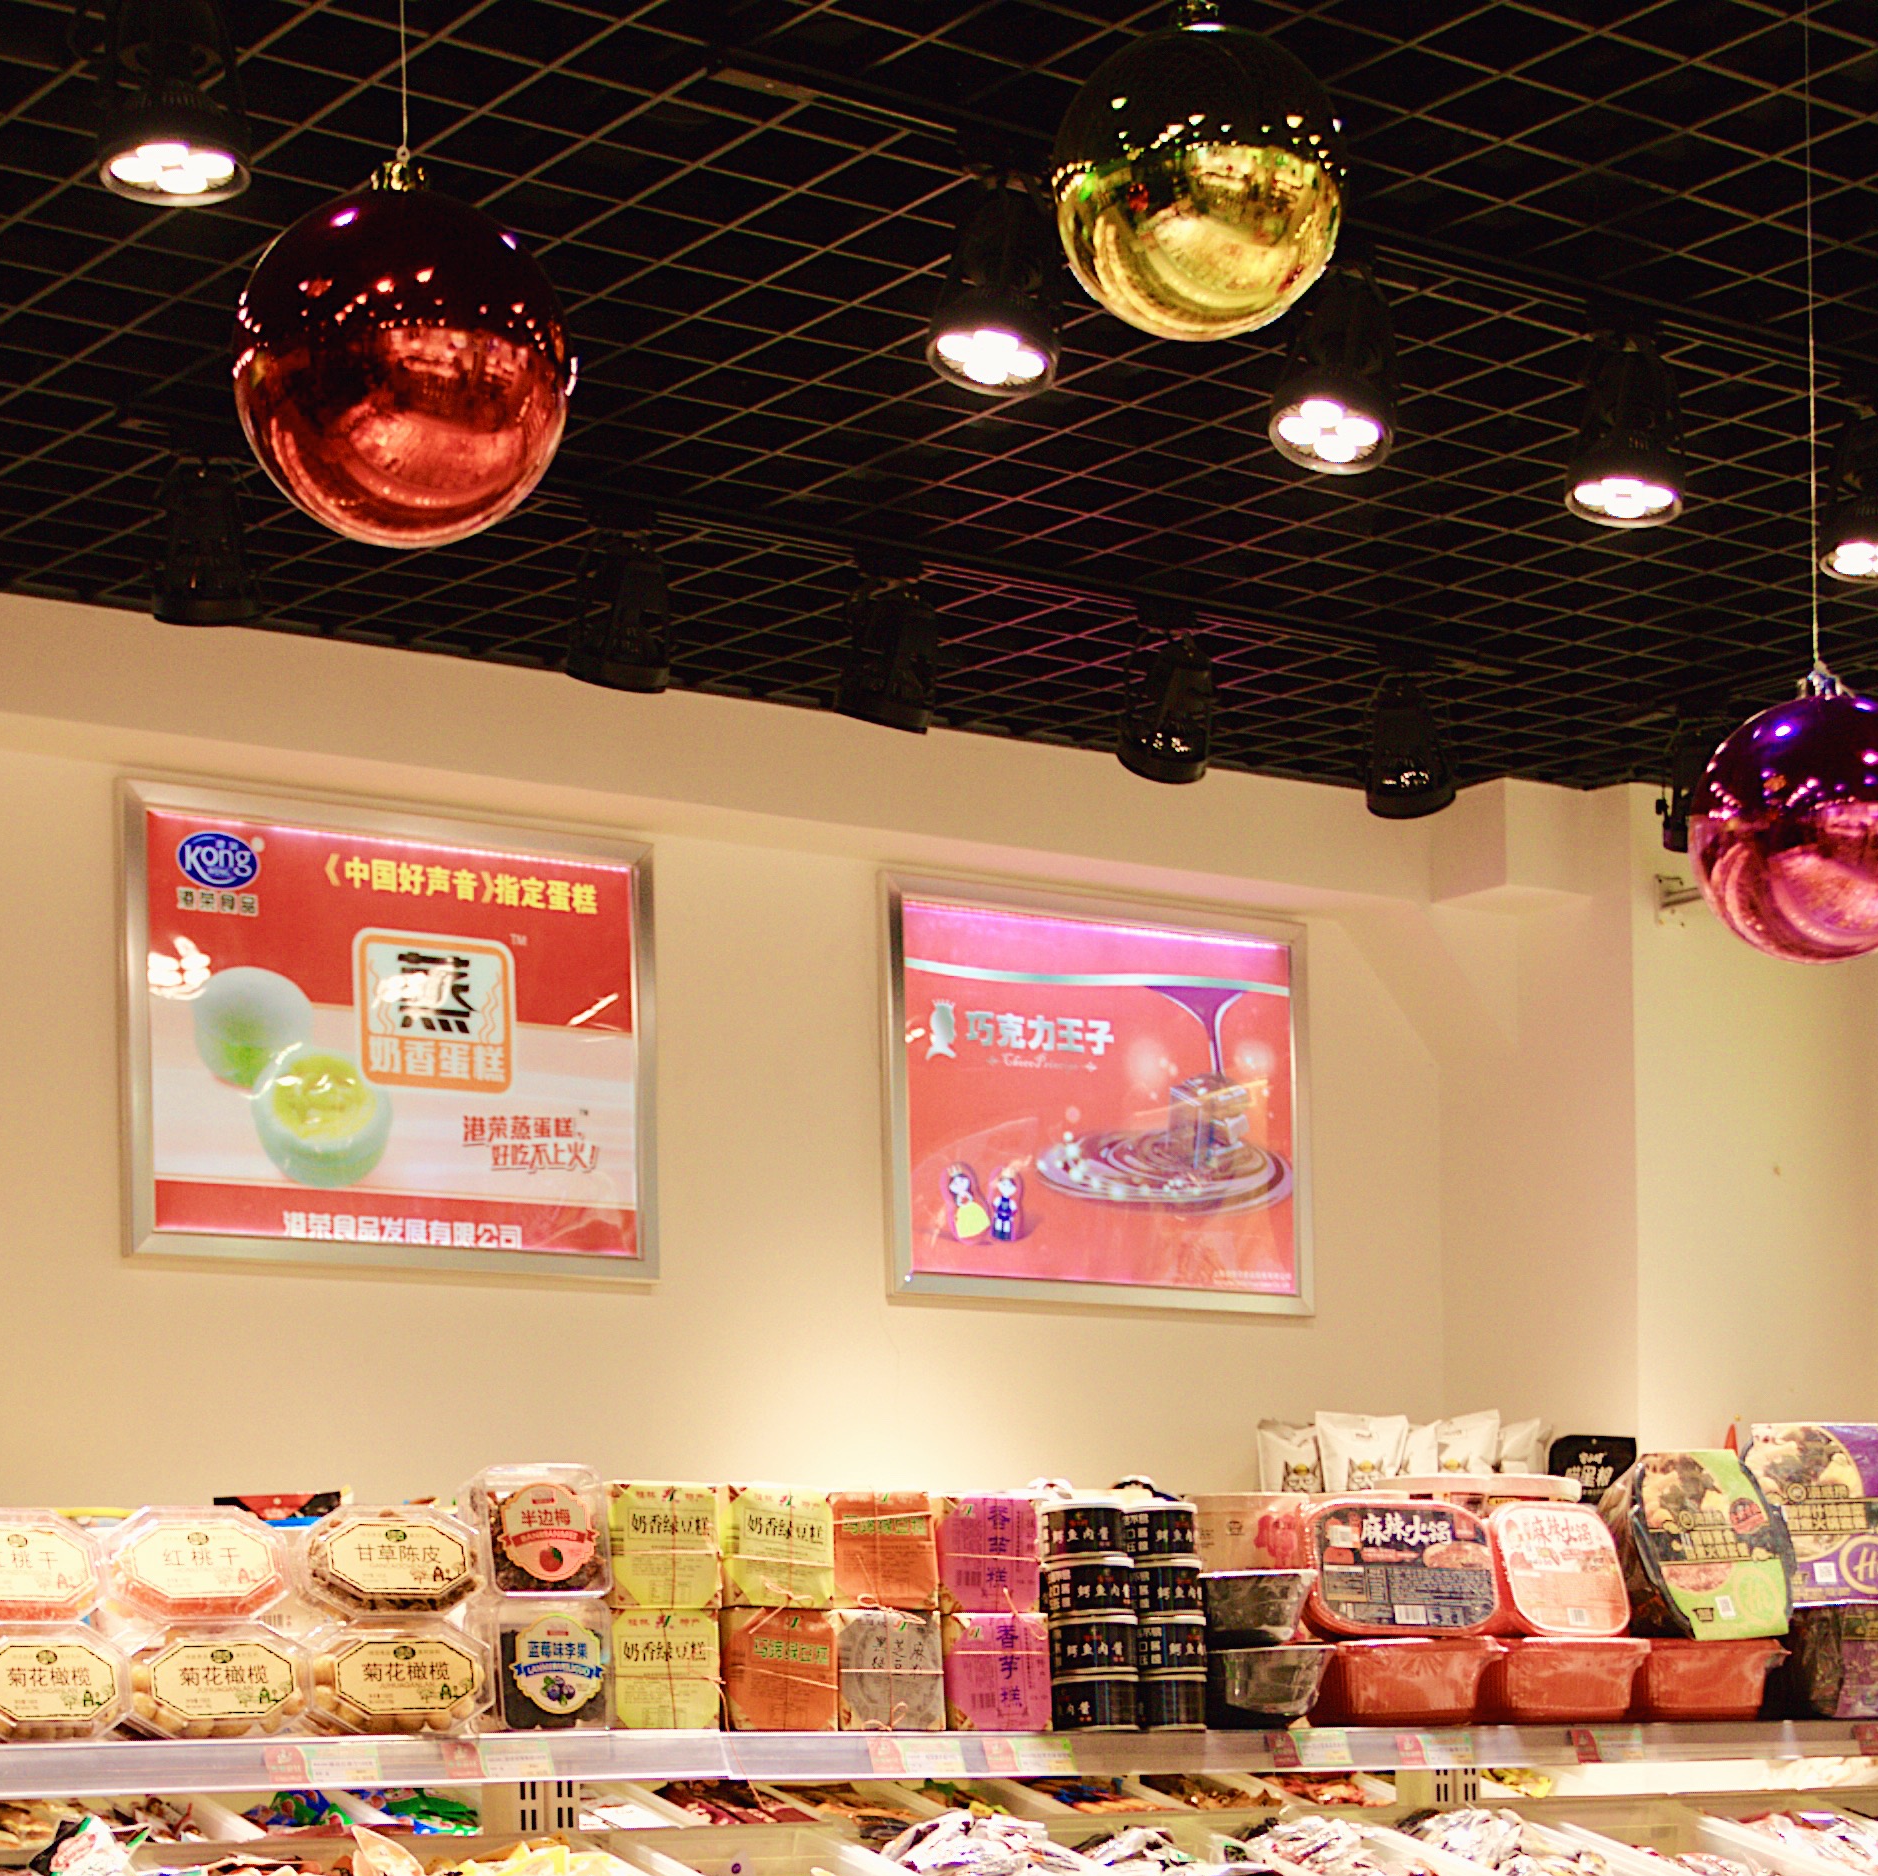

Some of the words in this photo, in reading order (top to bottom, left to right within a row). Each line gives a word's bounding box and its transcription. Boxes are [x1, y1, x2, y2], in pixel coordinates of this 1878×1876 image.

[325, 852, 599, 916] 《中国好声音》指定蛋糕
[965, 1010, 1115, 1057] 巧克力王子
[368, 1036, 506, 1084] 奶香蛋糕
[282, 1211, 524, 1251] 港荣食品发展有限公司
[521, 1508, 571, 1527] 半边梅
[631, 1512, 711, 1536] 奶香绿豆糕
[1360, 1511, 1454, 1547] 麻辣火锅
[747, 1514, 825, 1546] 奶香绿豆糕
[1526, 1515, 1597, 1546] 麻辣火锅
[163, 1546, 242, 1568] 红桃干
[355, 1544, 443, 1564] 甘草陈皮
[623, 1641, 708, 1663] 奶香绿豆糕
[7, 1666, 92, 1688] 菊花橄榄
[178, 1666, 270, 1686] 菊花橄榄
[362, 1662, 451, 1682] 菊花橄榄
